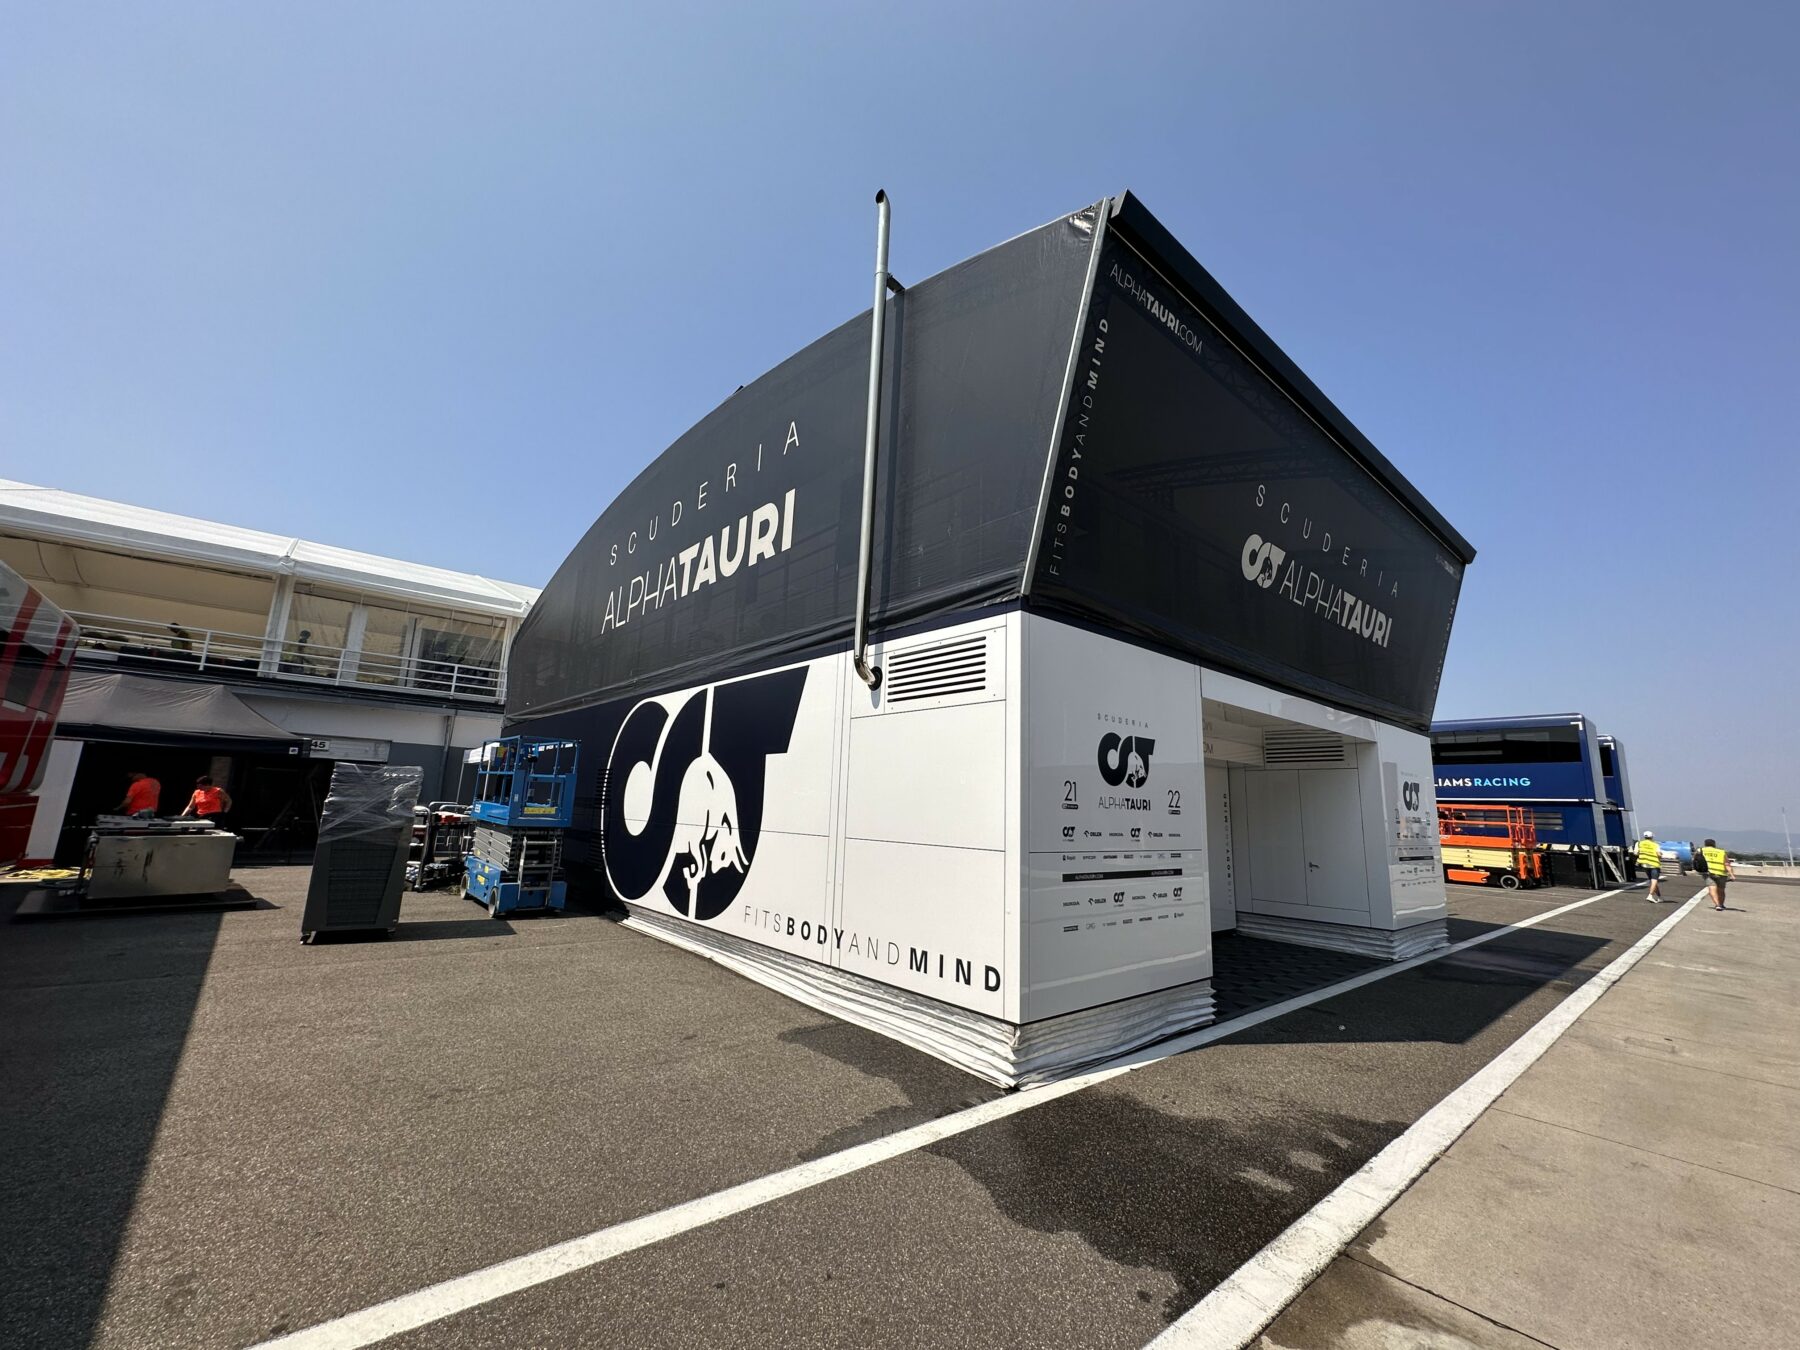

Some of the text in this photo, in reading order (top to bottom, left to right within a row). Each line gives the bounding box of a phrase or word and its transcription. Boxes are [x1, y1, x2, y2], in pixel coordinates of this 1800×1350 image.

[1109, 263, 1203, 354] ALPHATAURI.COM
[1049, 318, 1109, 576] FITSBODYANDMIND
[609, 421, 799, 566] SCUDERIA
[601, 488, 796, 634] ALPHATAURI
[1255, 484, 1399, 598] SCUDERIA
[1279, 559, 1393, 648] ALPHATAURI
[1097, 712, 1149, 729] SCUDERIA
[1064, 780, 1077, 802] 21
[1098, 796, 1151, 811] ALPHATAURI
[1167, 789, 1181, 809] 22
[744, 905, 1001, 993] FITSBODYANDMIND
